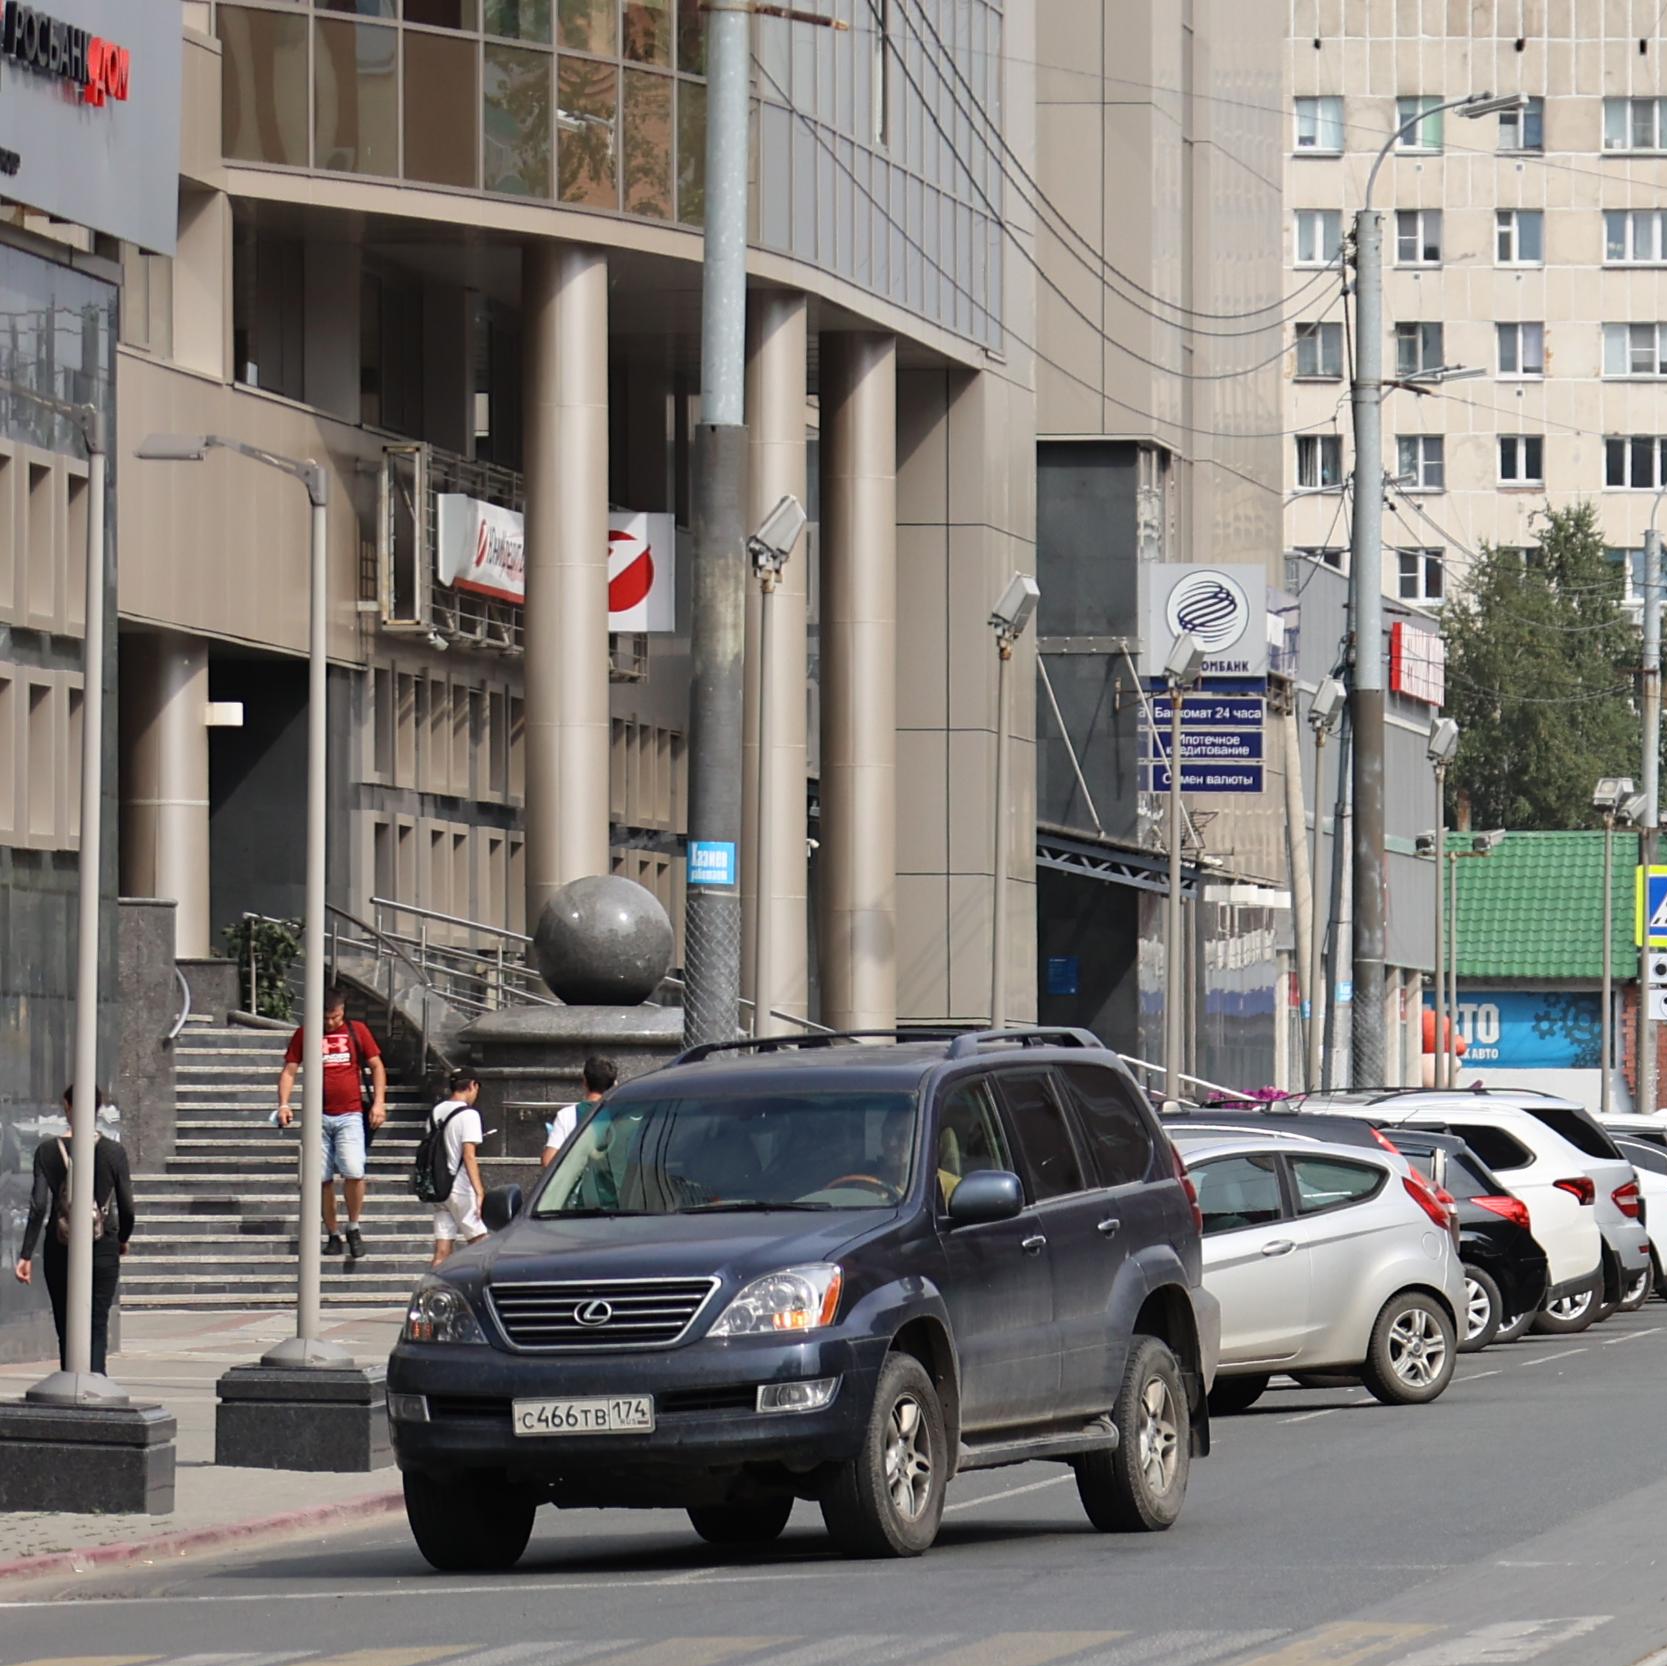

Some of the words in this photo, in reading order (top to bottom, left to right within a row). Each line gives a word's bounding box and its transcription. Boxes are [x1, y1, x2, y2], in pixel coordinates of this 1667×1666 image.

[1154, 706, 1212, 719] Бакомат
[1215, 706, 1230, 719] 24
[1233, 709, 1262, 719] часа
[1165, 746, 1250, 756] кедитование
[1206, 776, 1253, 785] валюты
[611, 1400, 647, 1420] 174
